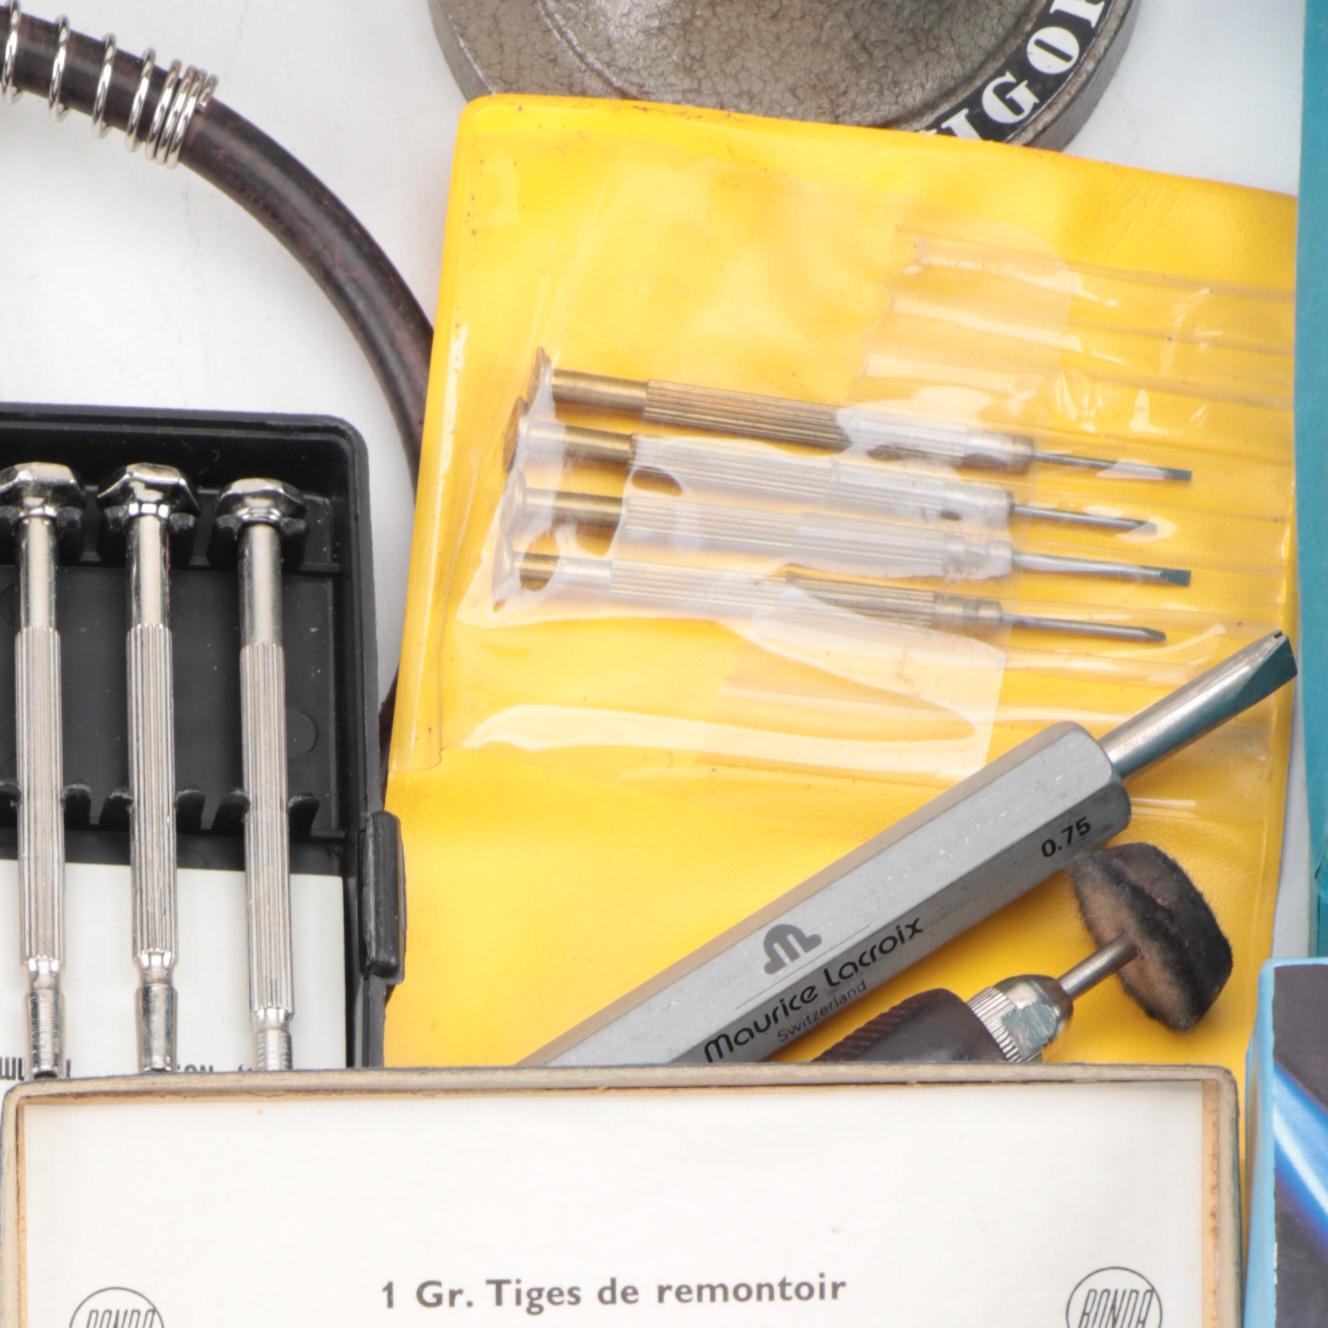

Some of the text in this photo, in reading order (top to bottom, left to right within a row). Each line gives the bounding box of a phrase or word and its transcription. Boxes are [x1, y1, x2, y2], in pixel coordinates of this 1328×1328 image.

[1041, 816, 1092, 858] 0.75
[703, 917, 924, 1063] Maurice Lacroix
[776, 980, 868, 1042] Switzerland
[382, 1272, 846, 1316] 1 Gr. Tiges de remontoir
